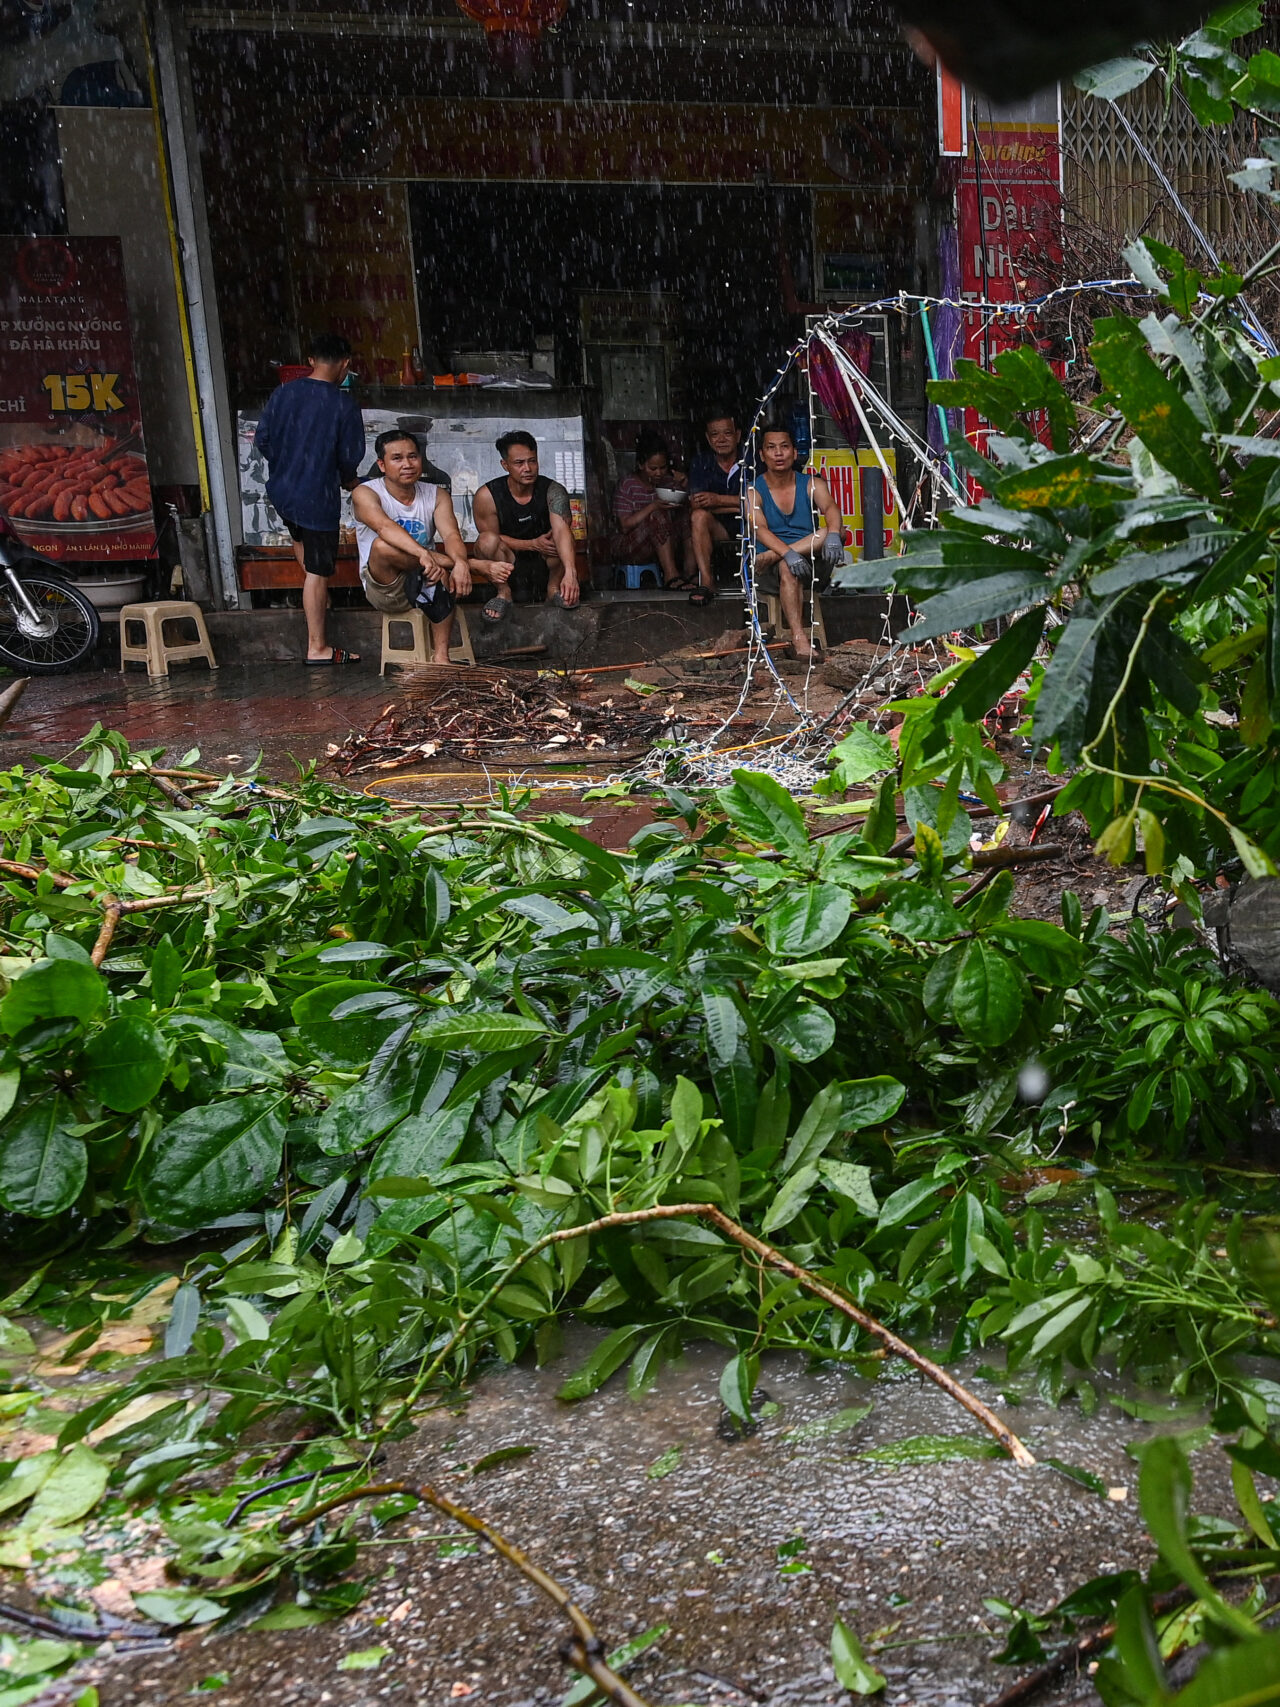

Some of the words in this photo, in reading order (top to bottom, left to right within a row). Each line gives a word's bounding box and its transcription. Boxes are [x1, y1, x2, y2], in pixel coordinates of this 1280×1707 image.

[18, 296, 85, 304] MALATANG
[68, 316, 122, 332] NƯỚNG
[9, 336, 31, 350] ĐÁ
[34, 336, 55, 350] HÀ
[42, 373, 125, 411] 15K
